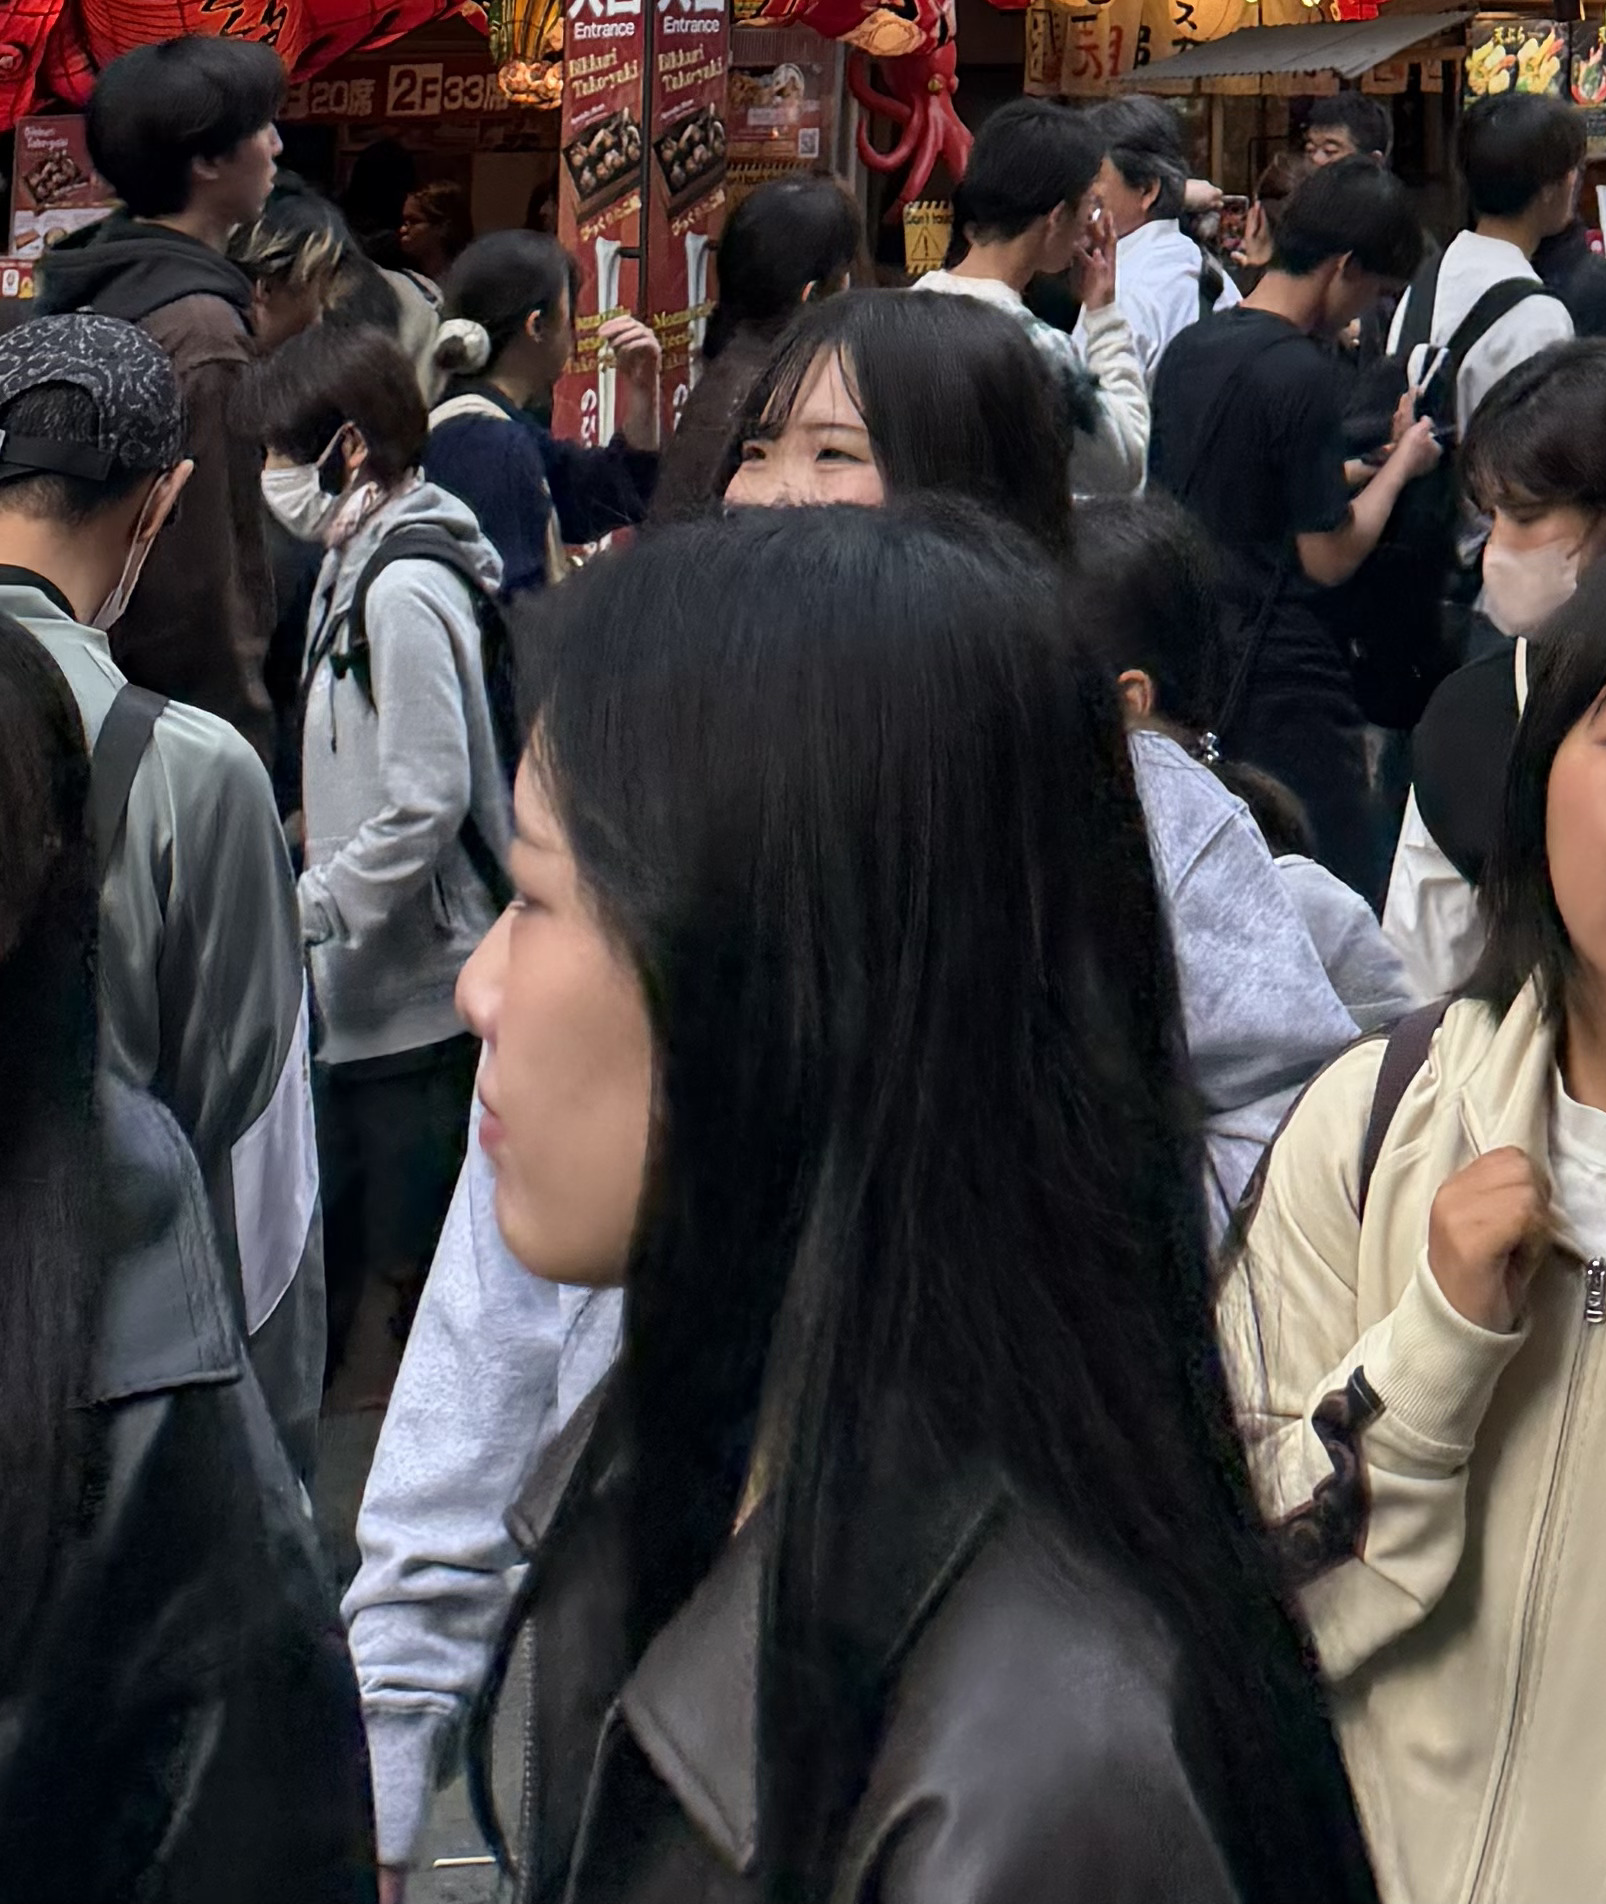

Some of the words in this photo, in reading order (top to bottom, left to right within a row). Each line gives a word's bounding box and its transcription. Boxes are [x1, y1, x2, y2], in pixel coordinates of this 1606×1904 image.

[572, 20, 636, 41] Entrance
[663, 16, 721, 35] Entrance
[391, 68, 441, 112] 2F
